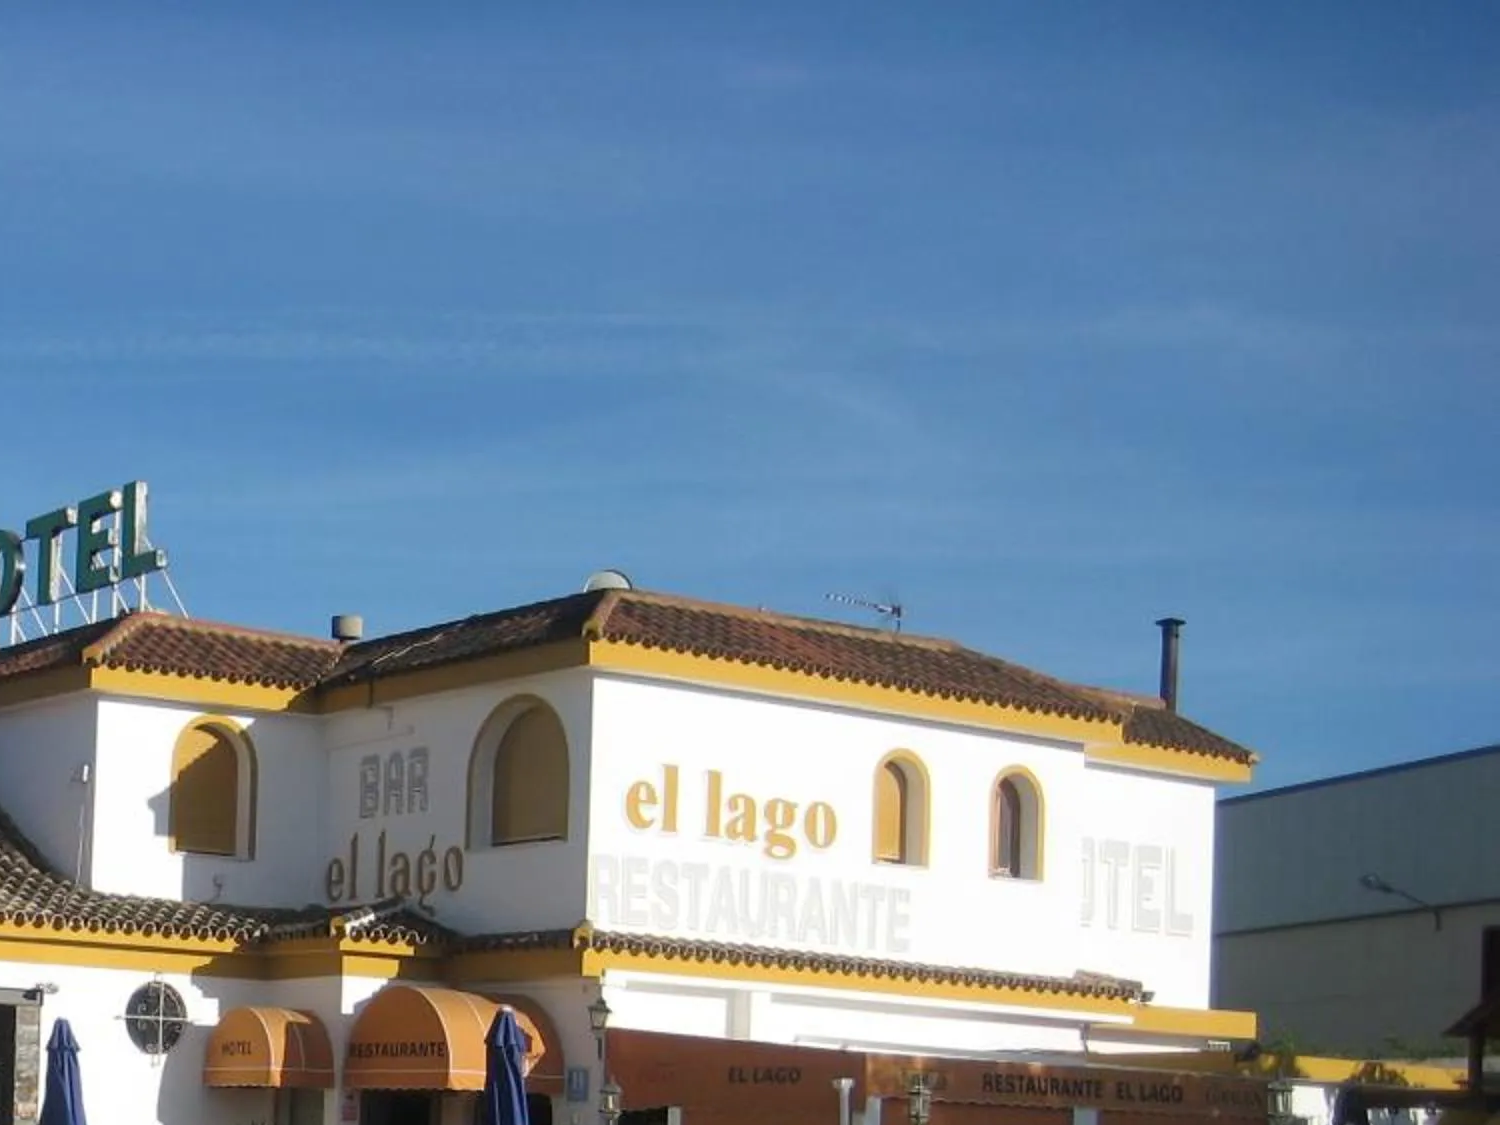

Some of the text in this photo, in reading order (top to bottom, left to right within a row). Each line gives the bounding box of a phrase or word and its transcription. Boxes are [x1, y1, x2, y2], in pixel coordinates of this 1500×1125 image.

[359, 746, 430, 819] BAR
[624, 763, 838, 860] el lago
[326, 828, 465, 918] el lago
[586, 853, 912, 952] RESTAURANTE
[221, 1039, 252, 1057] HOTEL
[349, 1039, 445, 1059] RESTAURANTE
[727, 1065, 803, 1085] EL LAGO
[981, 1071, 1105, 1099] RESTAURANTE
[1117, 1081, 1134, 1100] EL
[1139, 1082, 1184, 1105] LAGO
